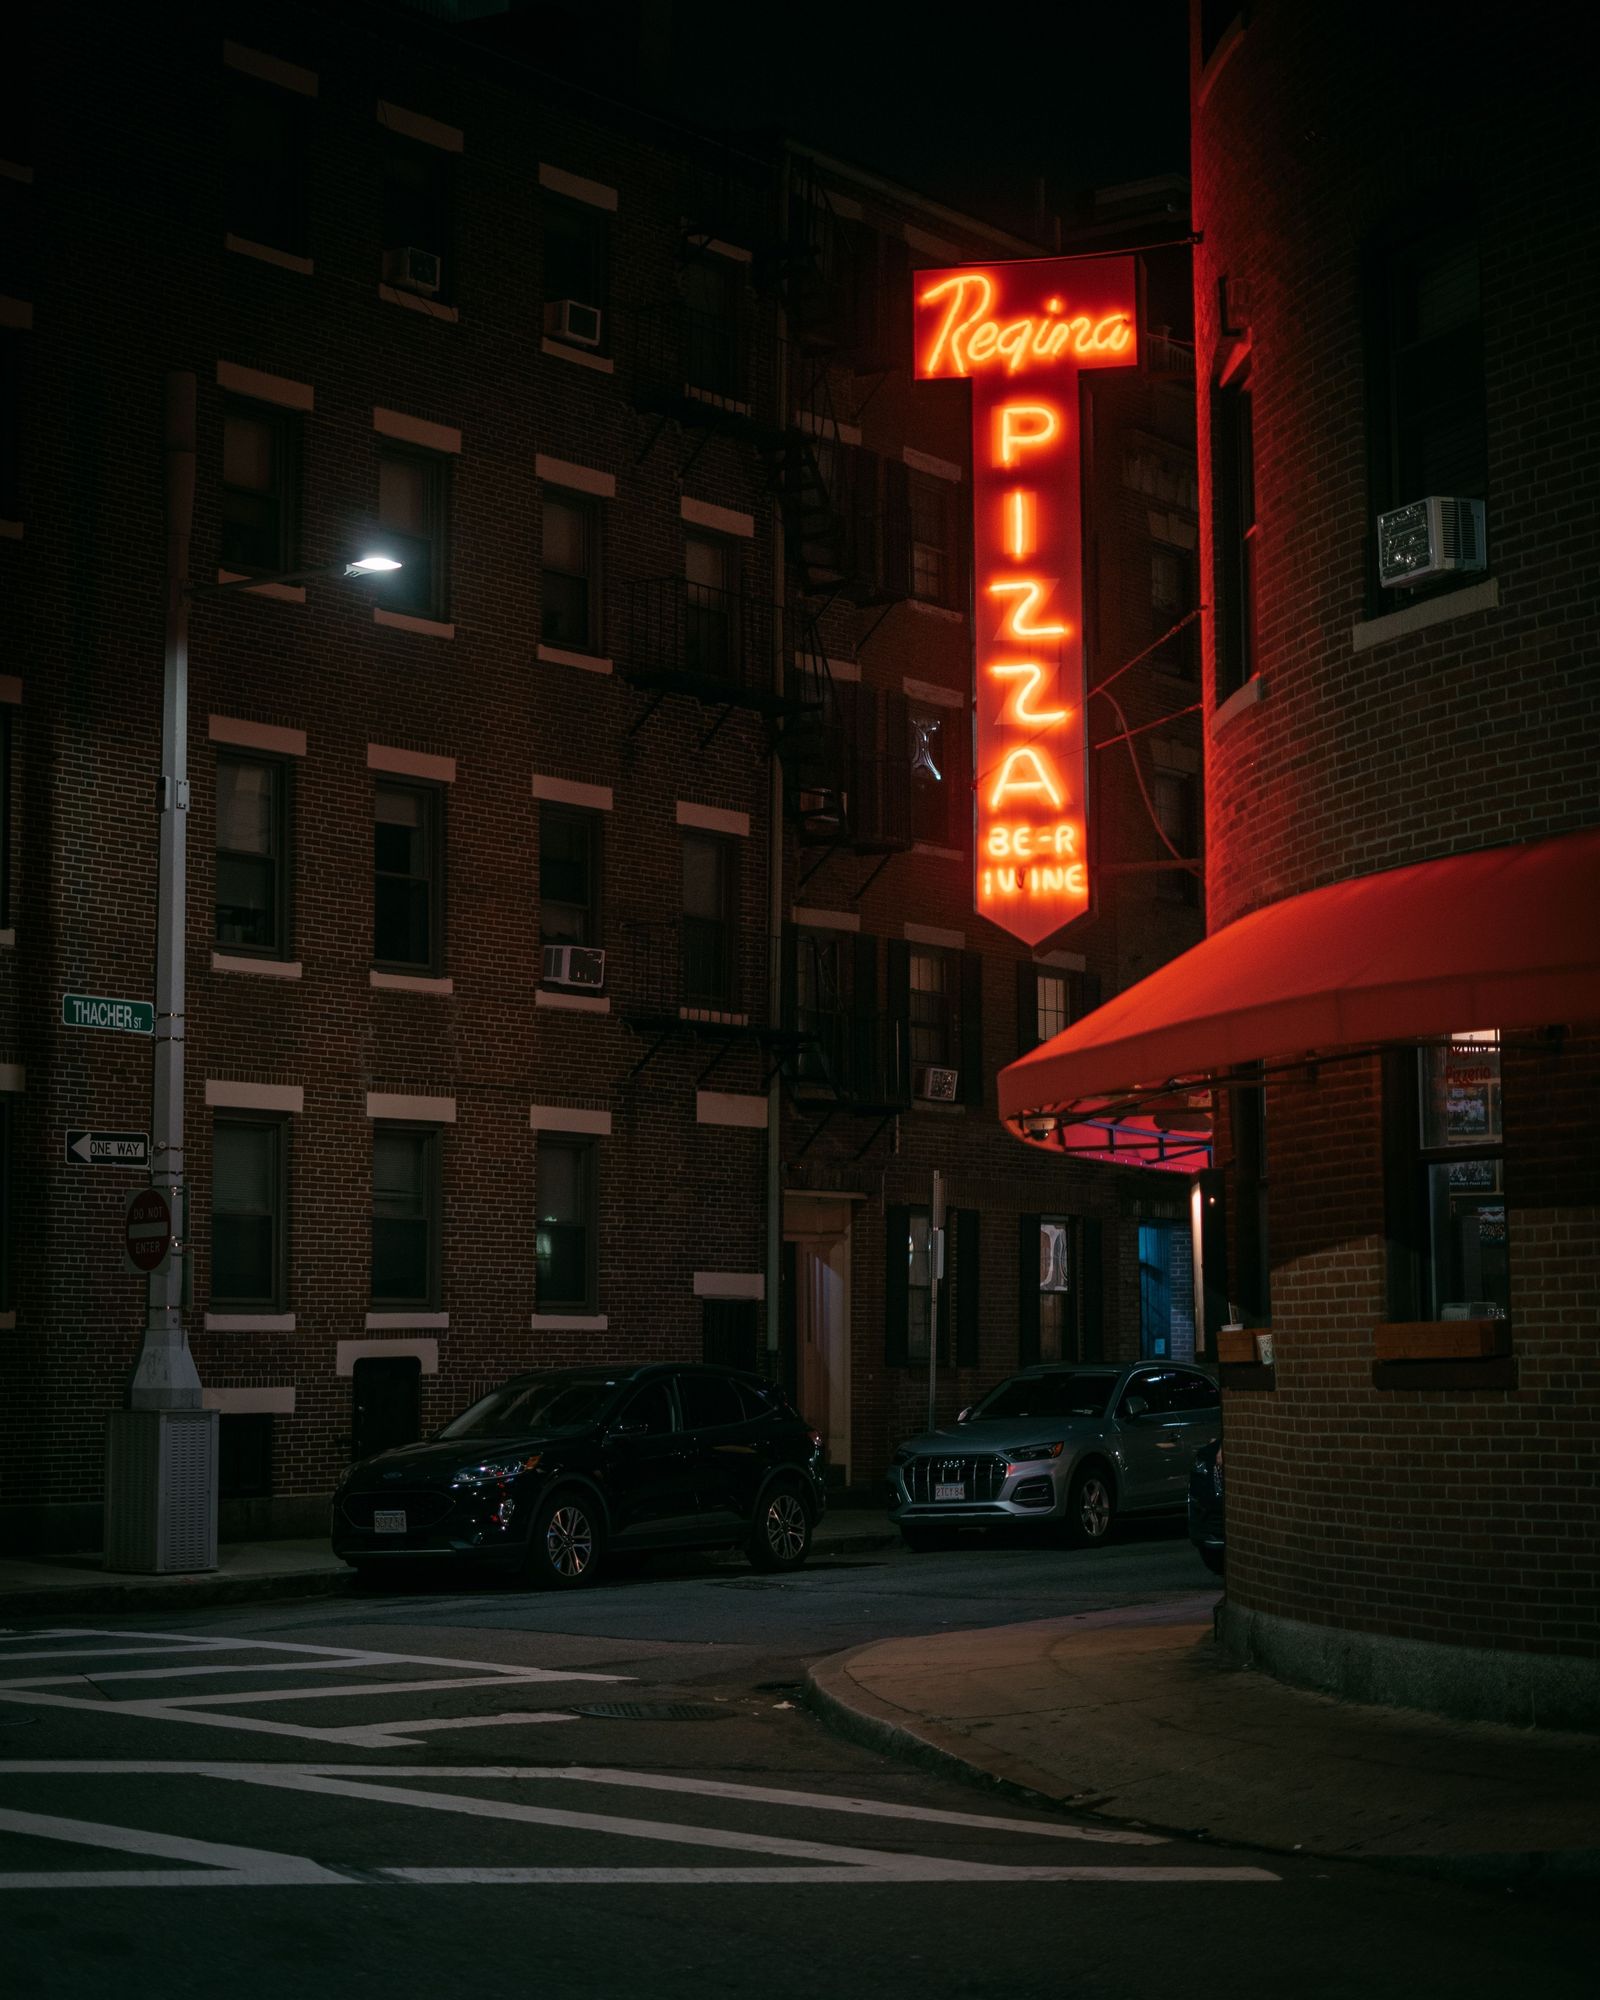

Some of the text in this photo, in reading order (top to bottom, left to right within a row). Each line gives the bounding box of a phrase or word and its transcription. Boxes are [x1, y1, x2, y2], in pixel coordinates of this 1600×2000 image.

[920, 274, 1131, 376] Regina
[989, 402, 1072, 809] PIZZA
[72, 999, 143, 1030] THACHER ST
[90, 1142, 140, 1156] ONE WAY
[133, 1206, 163, 1220] DO NOT
[135, 1241, 161, 1255] ENTER
